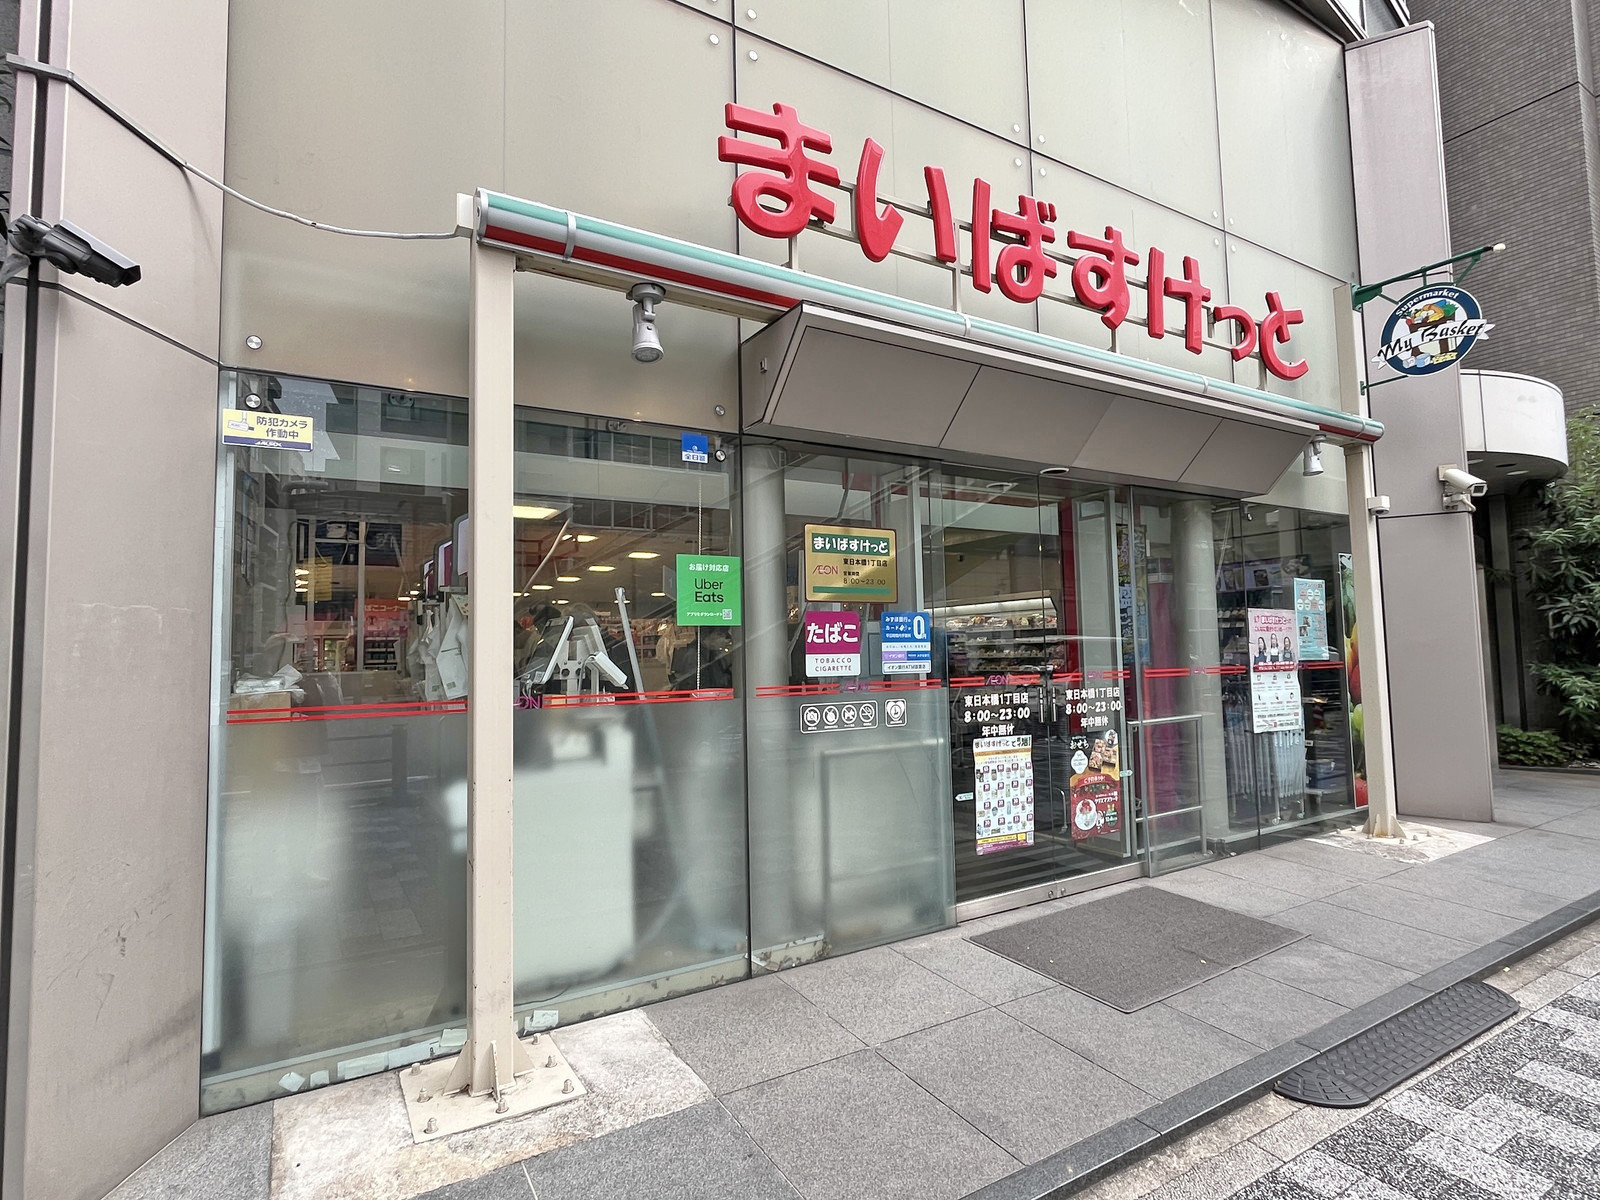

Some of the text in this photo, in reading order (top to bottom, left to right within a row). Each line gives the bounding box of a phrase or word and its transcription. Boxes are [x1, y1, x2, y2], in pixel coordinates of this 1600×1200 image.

[718, 102, 1309, 381] まいばすけっと
[1395, 288, 1460, 317] Supermarket
[1377, 319, 1485, 361] My Basket
[256, 415, 308, 429] 防犯カメラ
[265, 428, 299, 439] 作動中
[813, 536, 889, 554] まいばすけっと
[688, 563, 730, 573] お届け対応店
[842, 558, 888, 567] 東日本橋1丁目店
[694, 578, 724, 590] Uber
[694, 591, 725, 603] Eats
[364, 604, 407, 612] ばこコーナー
[807, 621, 859, 644] たばこ
[964, 692, 1029, 708] 東日本橋1丁目店
[1065, 687, 1120, 701] 東日本橋1丁目店
[1080, 715, 1109, 728] 年中無休
[981, 723, 1015, 738] 年中無休
[1070, 739, 1090, 750] おせち
